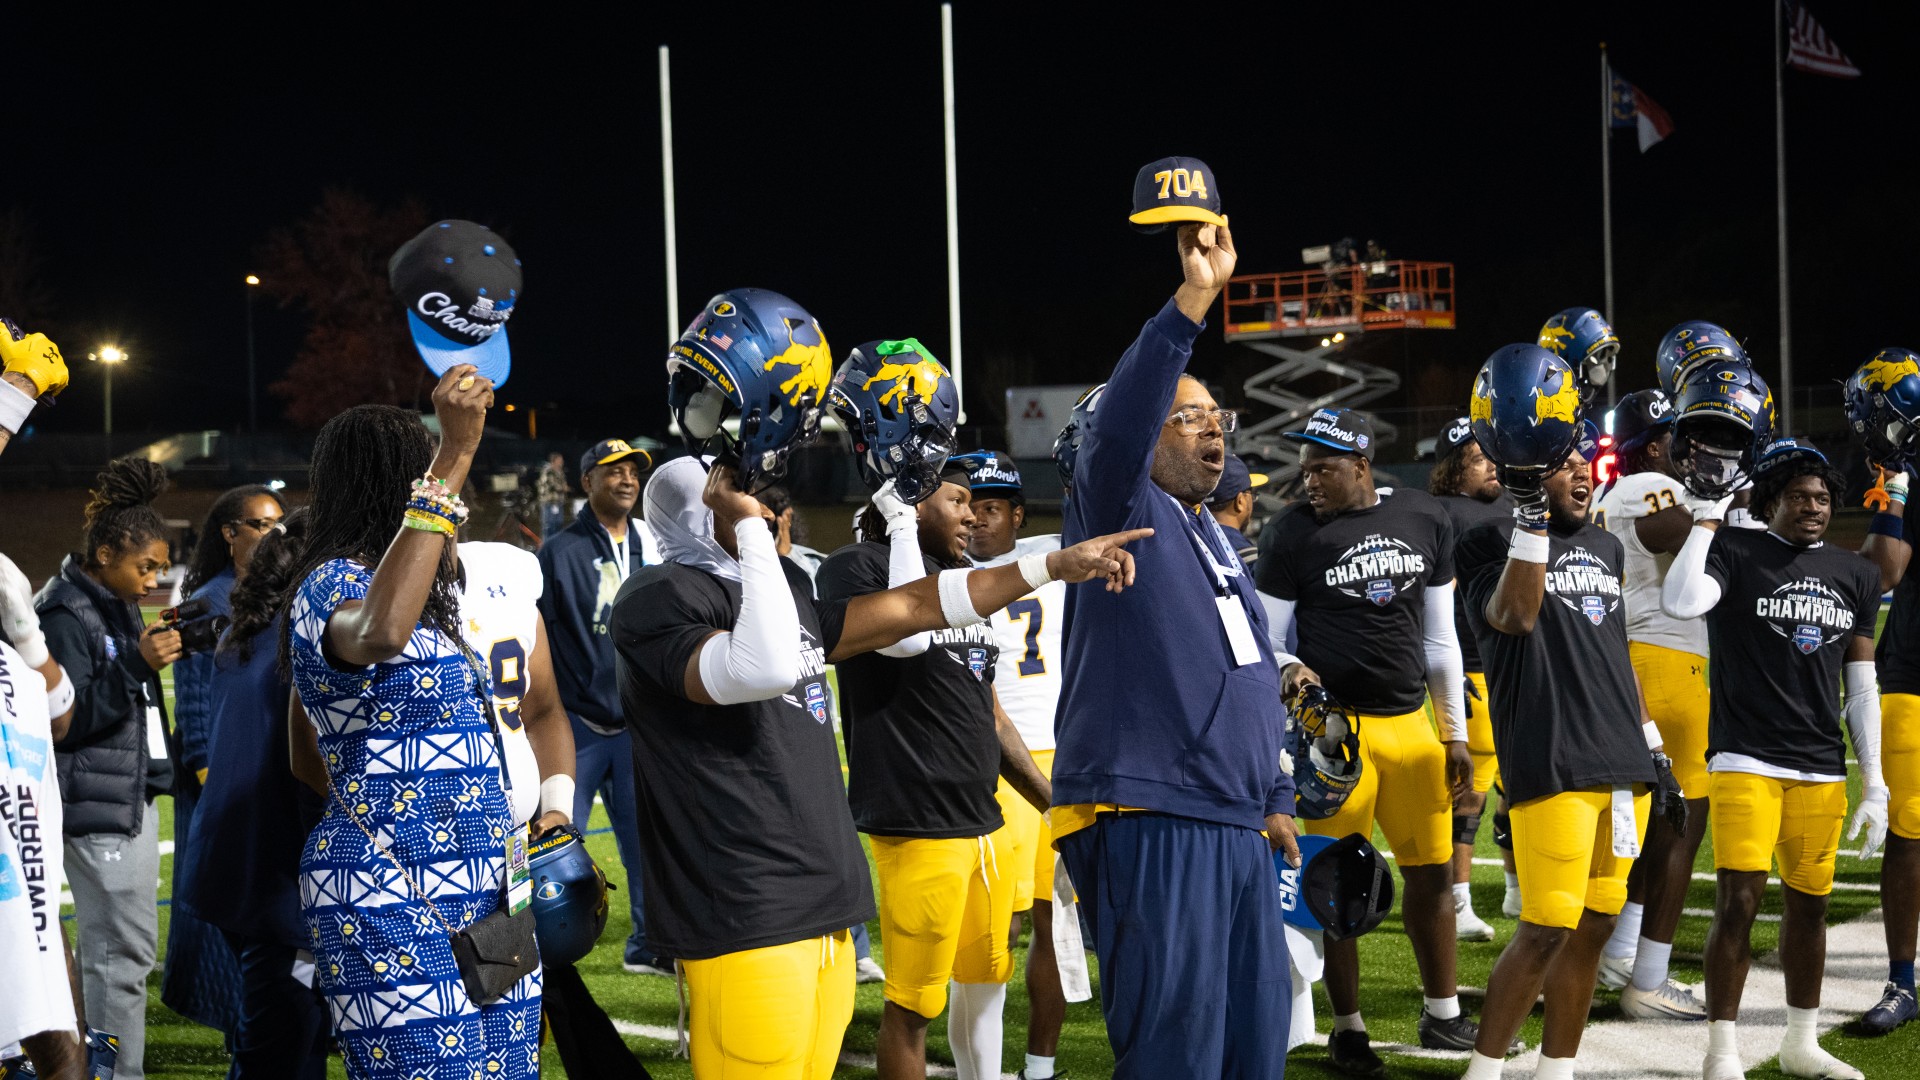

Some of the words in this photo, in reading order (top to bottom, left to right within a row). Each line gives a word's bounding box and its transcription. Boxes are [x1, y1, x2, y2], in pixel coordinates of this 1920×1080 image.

[1154, 168, 1208, 200] 704
[693, 353, 719, 377] EVERY
[718, 374, 735, 394] DAY
[1643, 488, 1677, 516] 33
[1325, 554, 1425, 587] CHAMPIONS
[1351, 549, 1400, 564] CONFERENCE
[1544, 571, 1621, 597] CHAMPIONS
[1756, 597, 1855, 630] CHAMPIONS
[1787, 593, 1835, 608] CONFERENCE
[1005, 596, 1048, 679] 7
[17, 784, 48, 951] OWERADE
